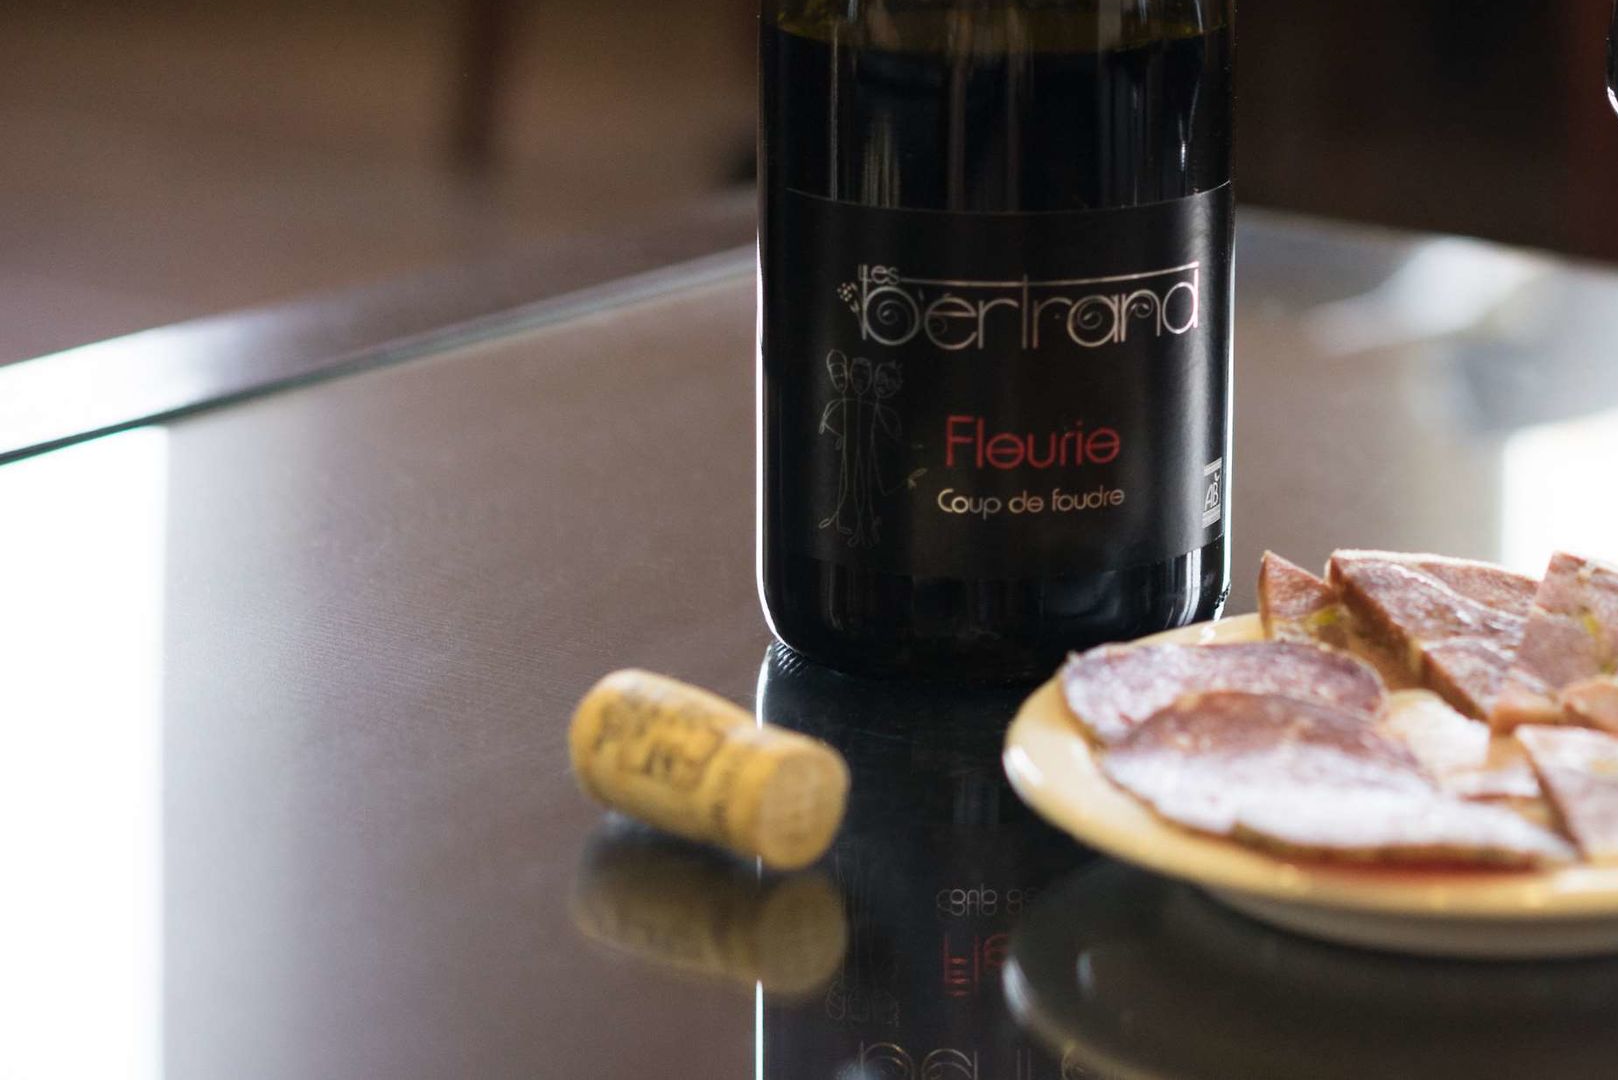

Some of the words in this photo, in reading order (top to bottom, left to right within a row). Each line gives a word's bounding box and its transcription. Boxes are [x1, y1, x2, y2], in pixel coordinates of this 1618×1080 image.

[861, 261, 1200, 351] bertrand
[946, 415, 1121, 469] Fleurie
[937, 488, 1003, 520] Coup
[1008, 490, 1045, 514] de
[1051, 485, 1126, 512] foudre
